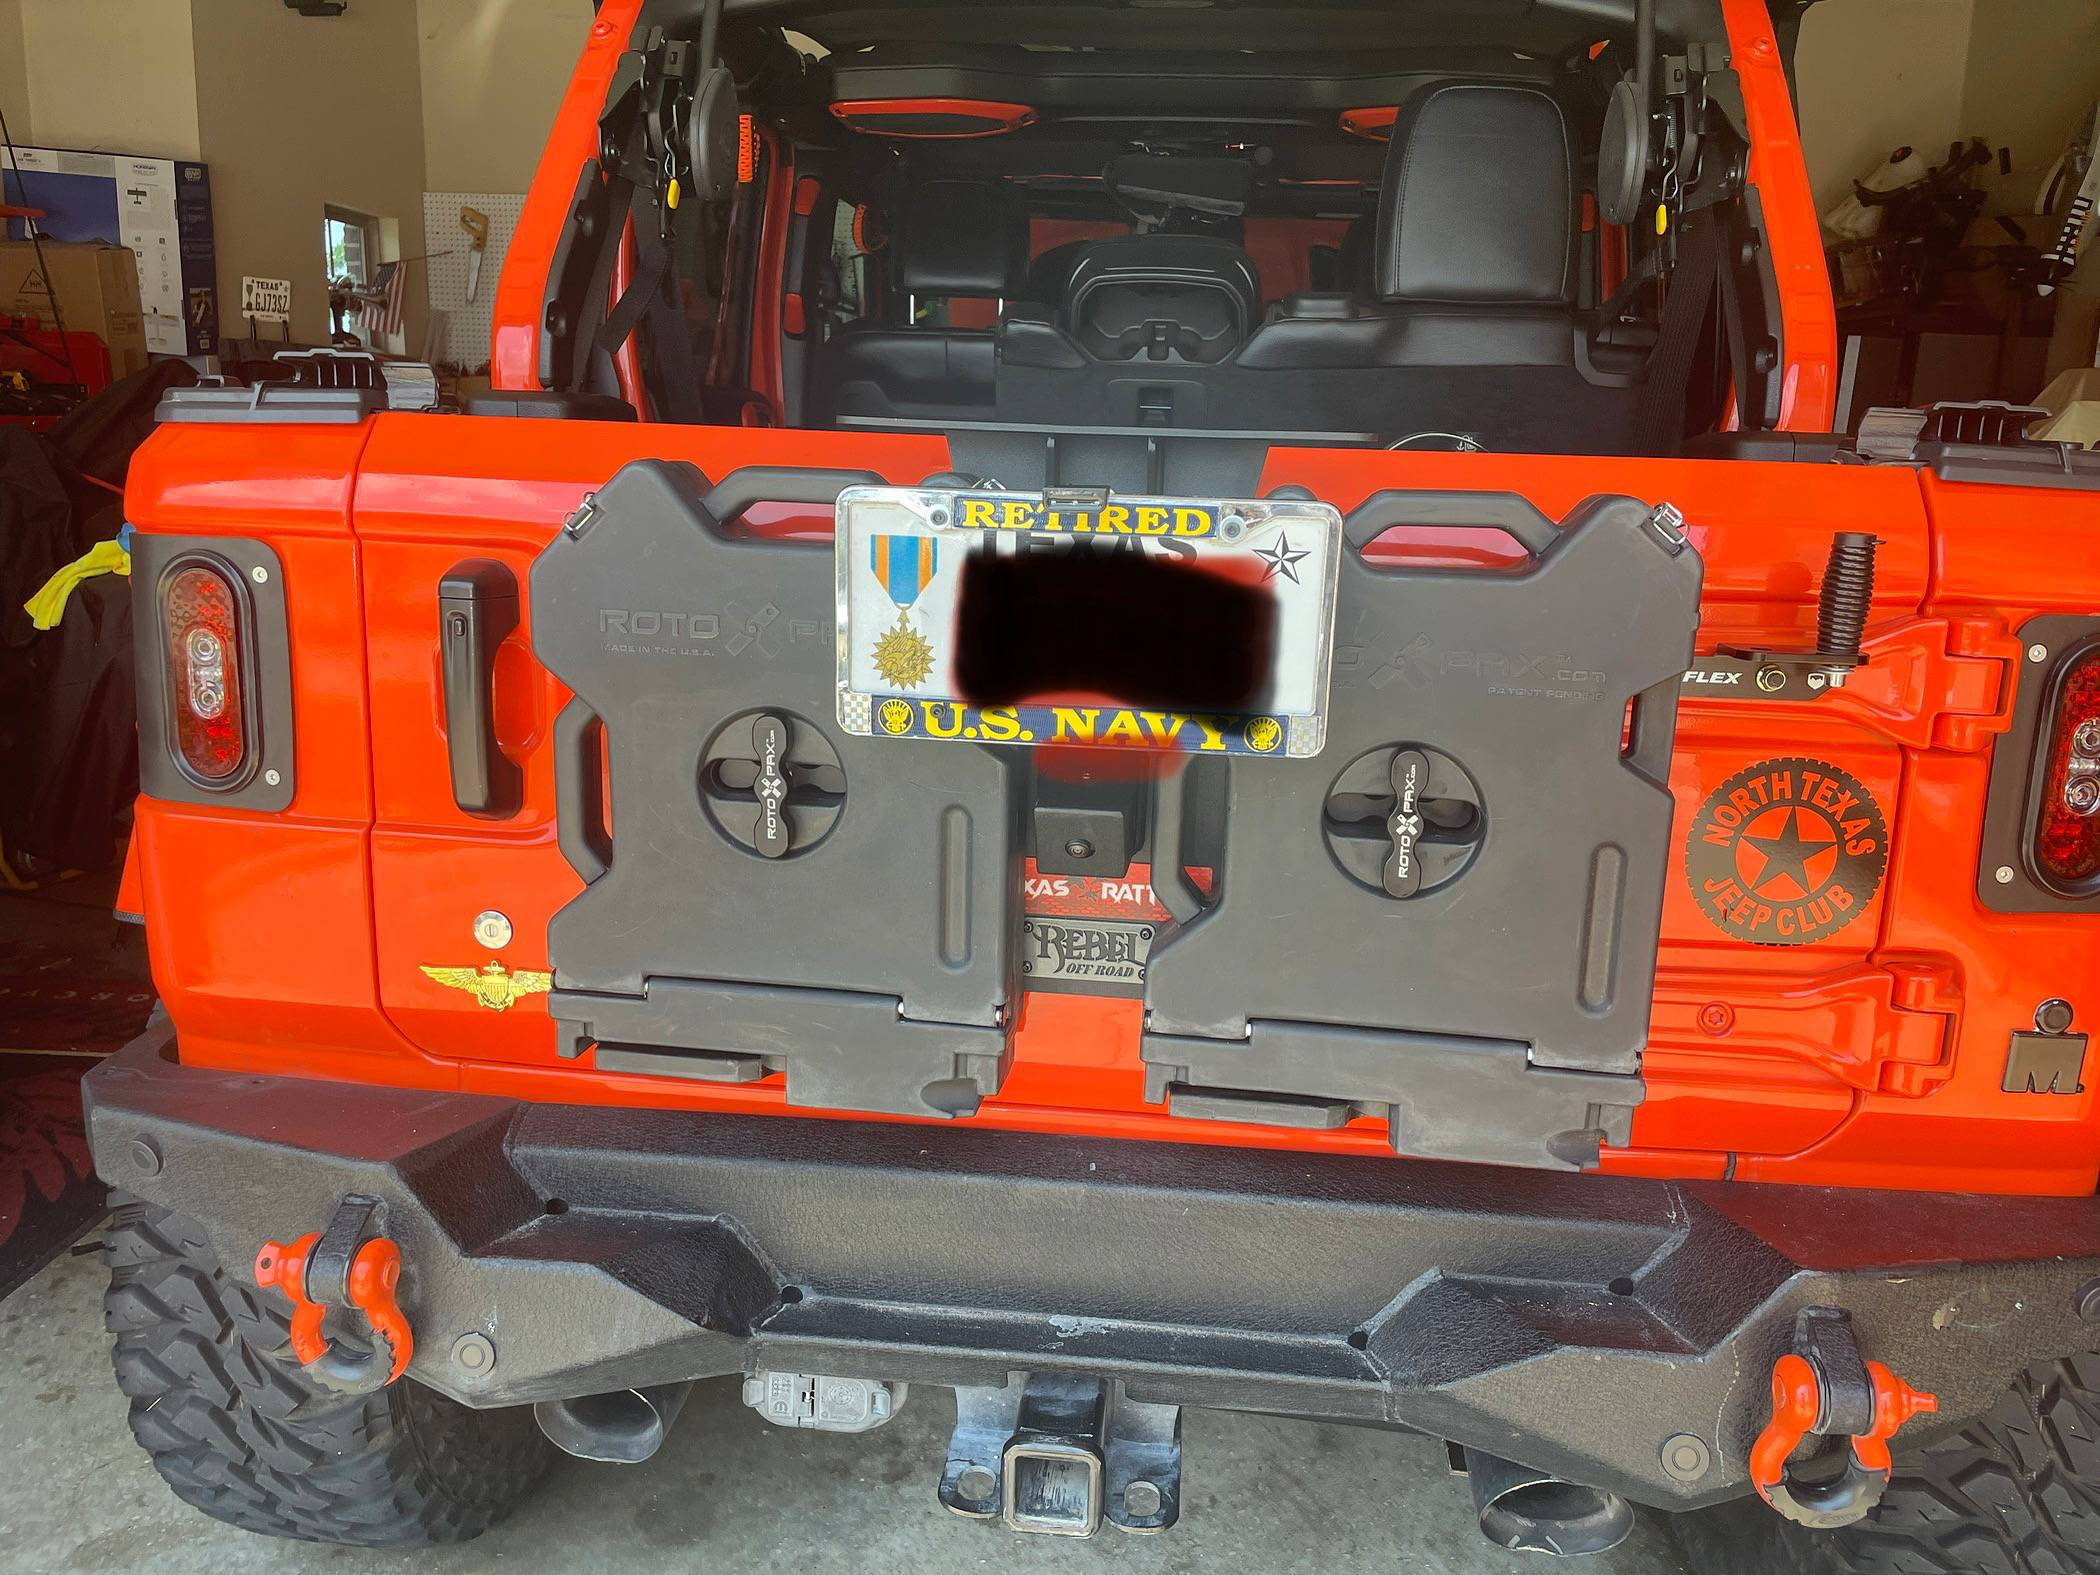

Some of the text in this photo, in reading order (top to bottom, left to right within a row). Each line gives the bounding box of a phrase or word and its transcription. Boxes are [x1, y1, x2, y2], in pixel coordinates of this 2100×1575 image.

[256, 281, 279, 291] TEXAS
[961, 499, 1212, 536] RETIRED
[599, 608, 720, 639] ROTO
[1682, 670, 1743, 685] FLEX
[920, 701, 1239, 750] U.S. NAVY
[767, 798, 777, 840] ROTO
[1702, 770, 1876, 856] NORTH TEXAS
[1398, 835, 1411, 878] ROTO
[1704, 877, 1854, 936] JEEP CLUB
[1066, 963, 1134, 978] OFF ROAD
